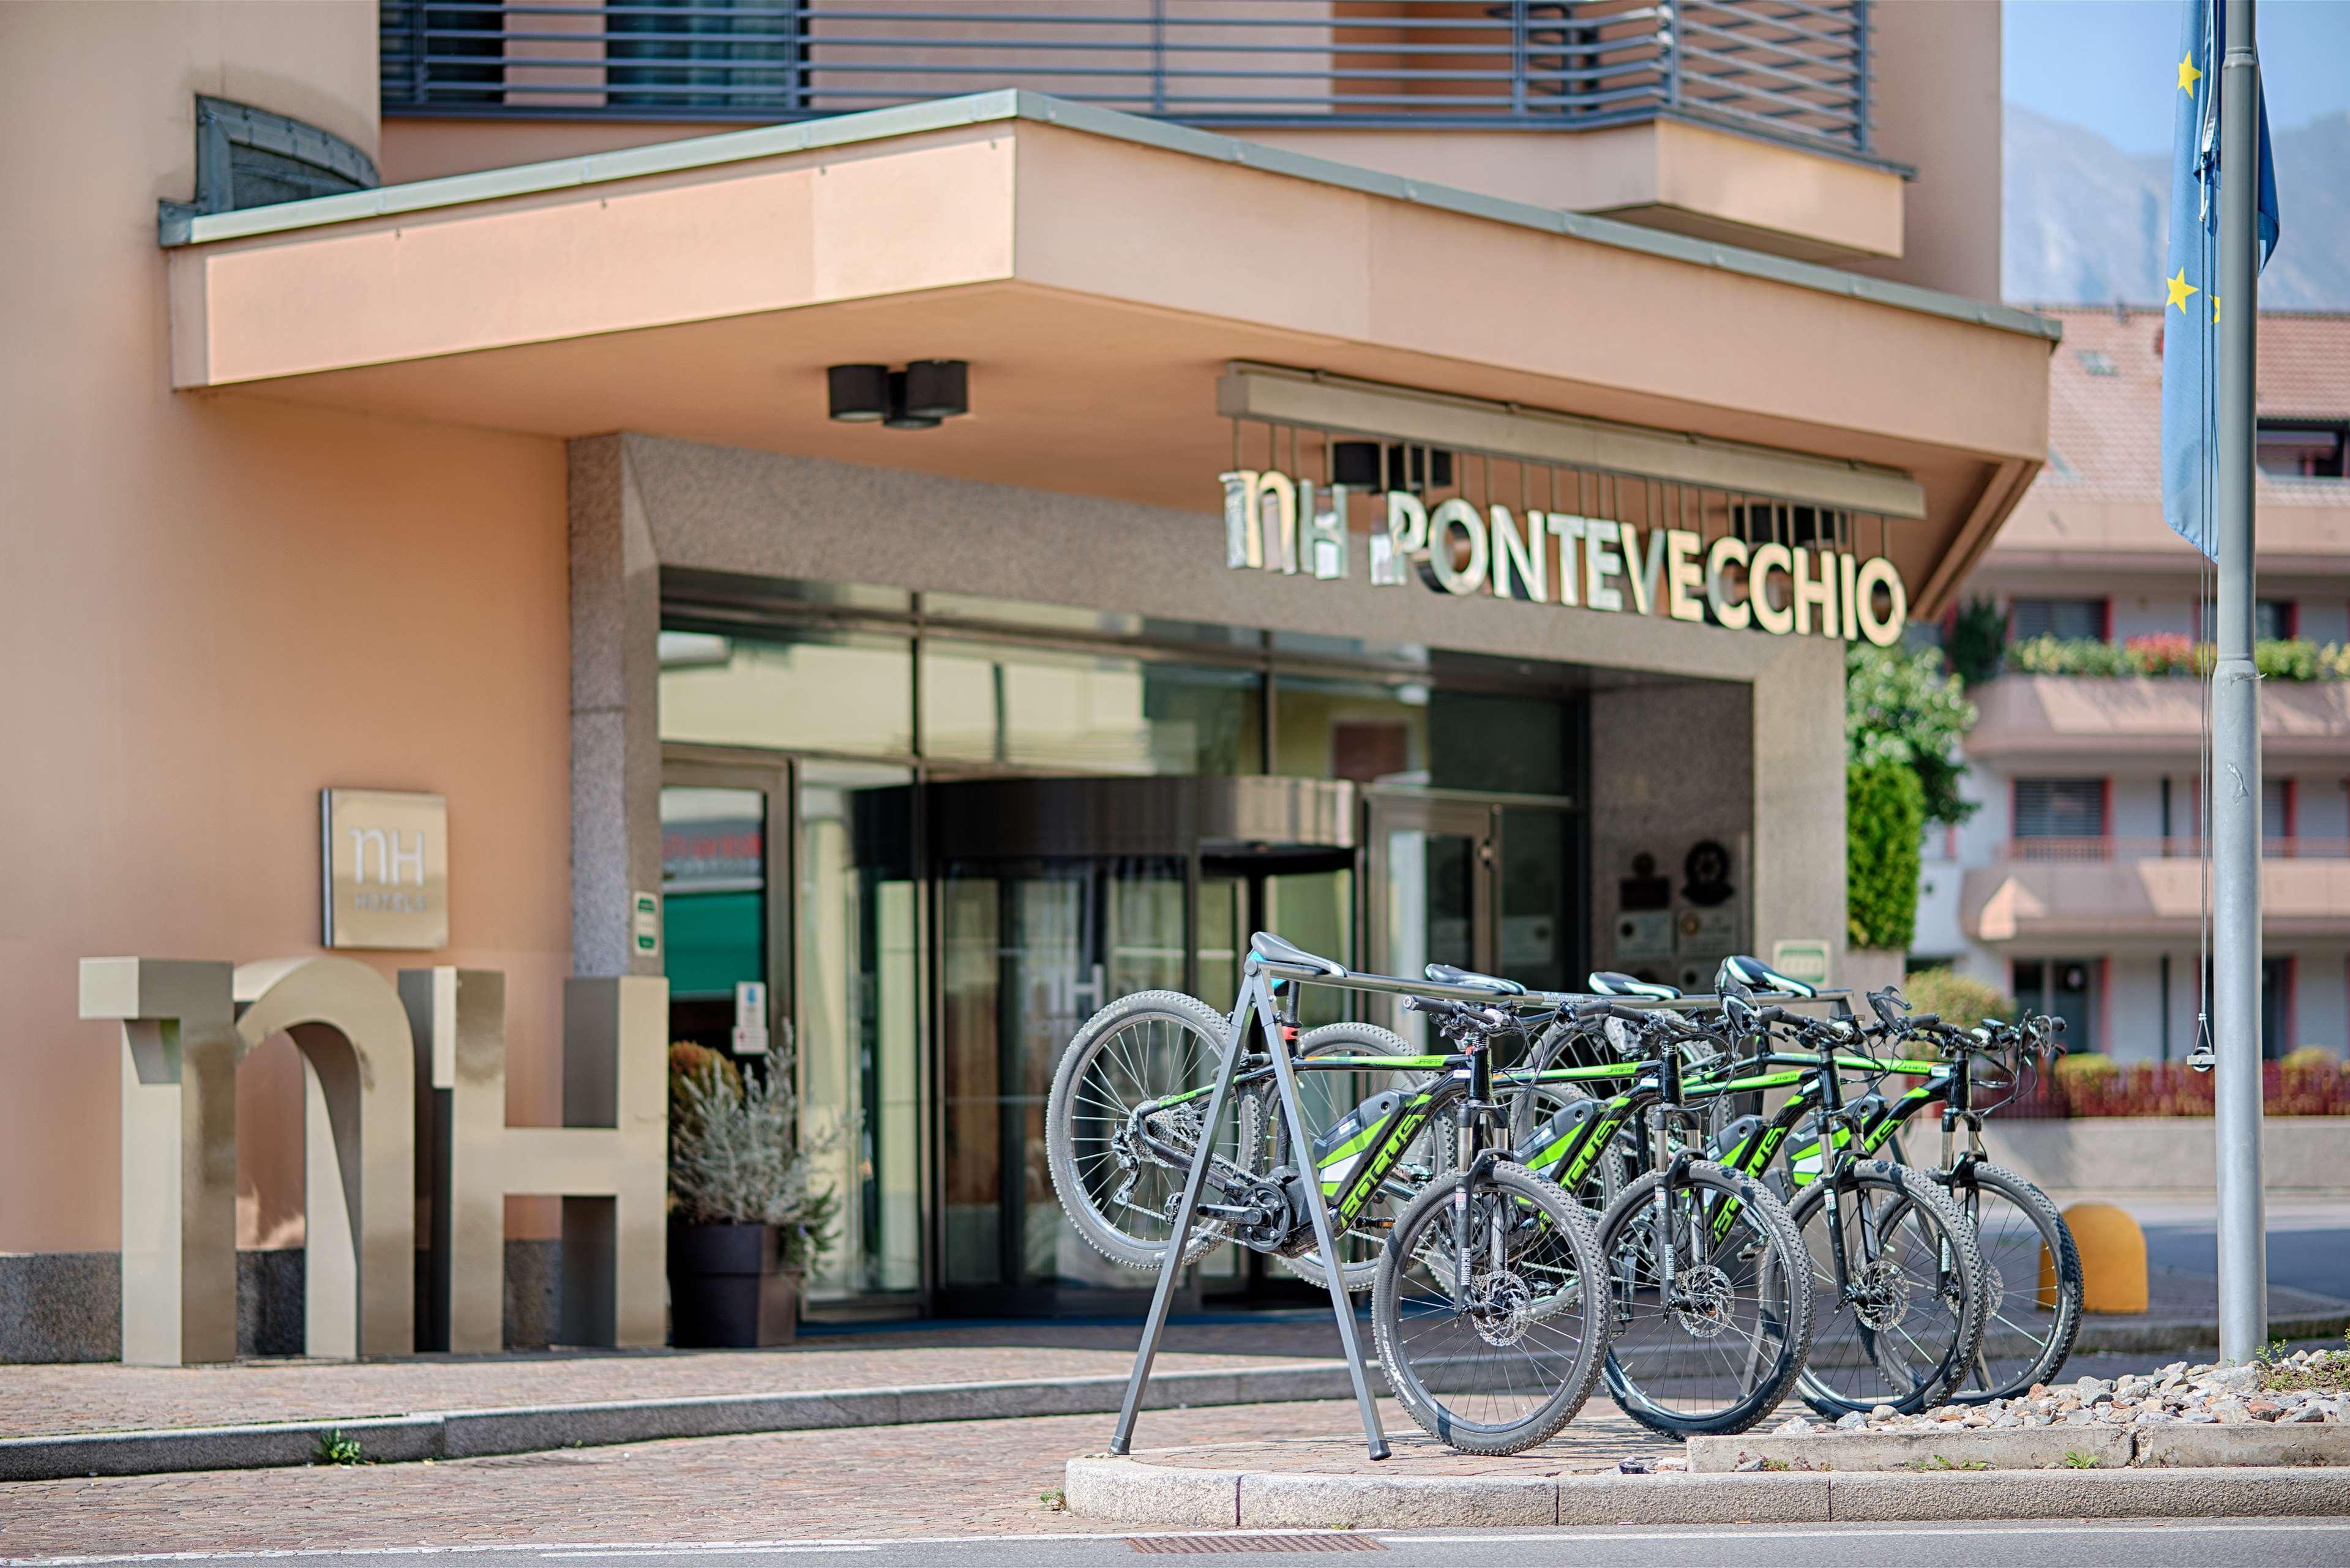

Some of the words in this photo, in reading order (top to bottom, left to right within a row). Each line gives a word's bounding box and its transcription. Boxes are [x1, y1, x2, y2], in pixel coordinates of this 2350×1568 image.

[1369, 491, 1906, 648] PONTEVECCHIO
[1340, 1114, 1427, 1228] FOCUS
[1461, 1247, 1470, 1286] ROCKSHOX
